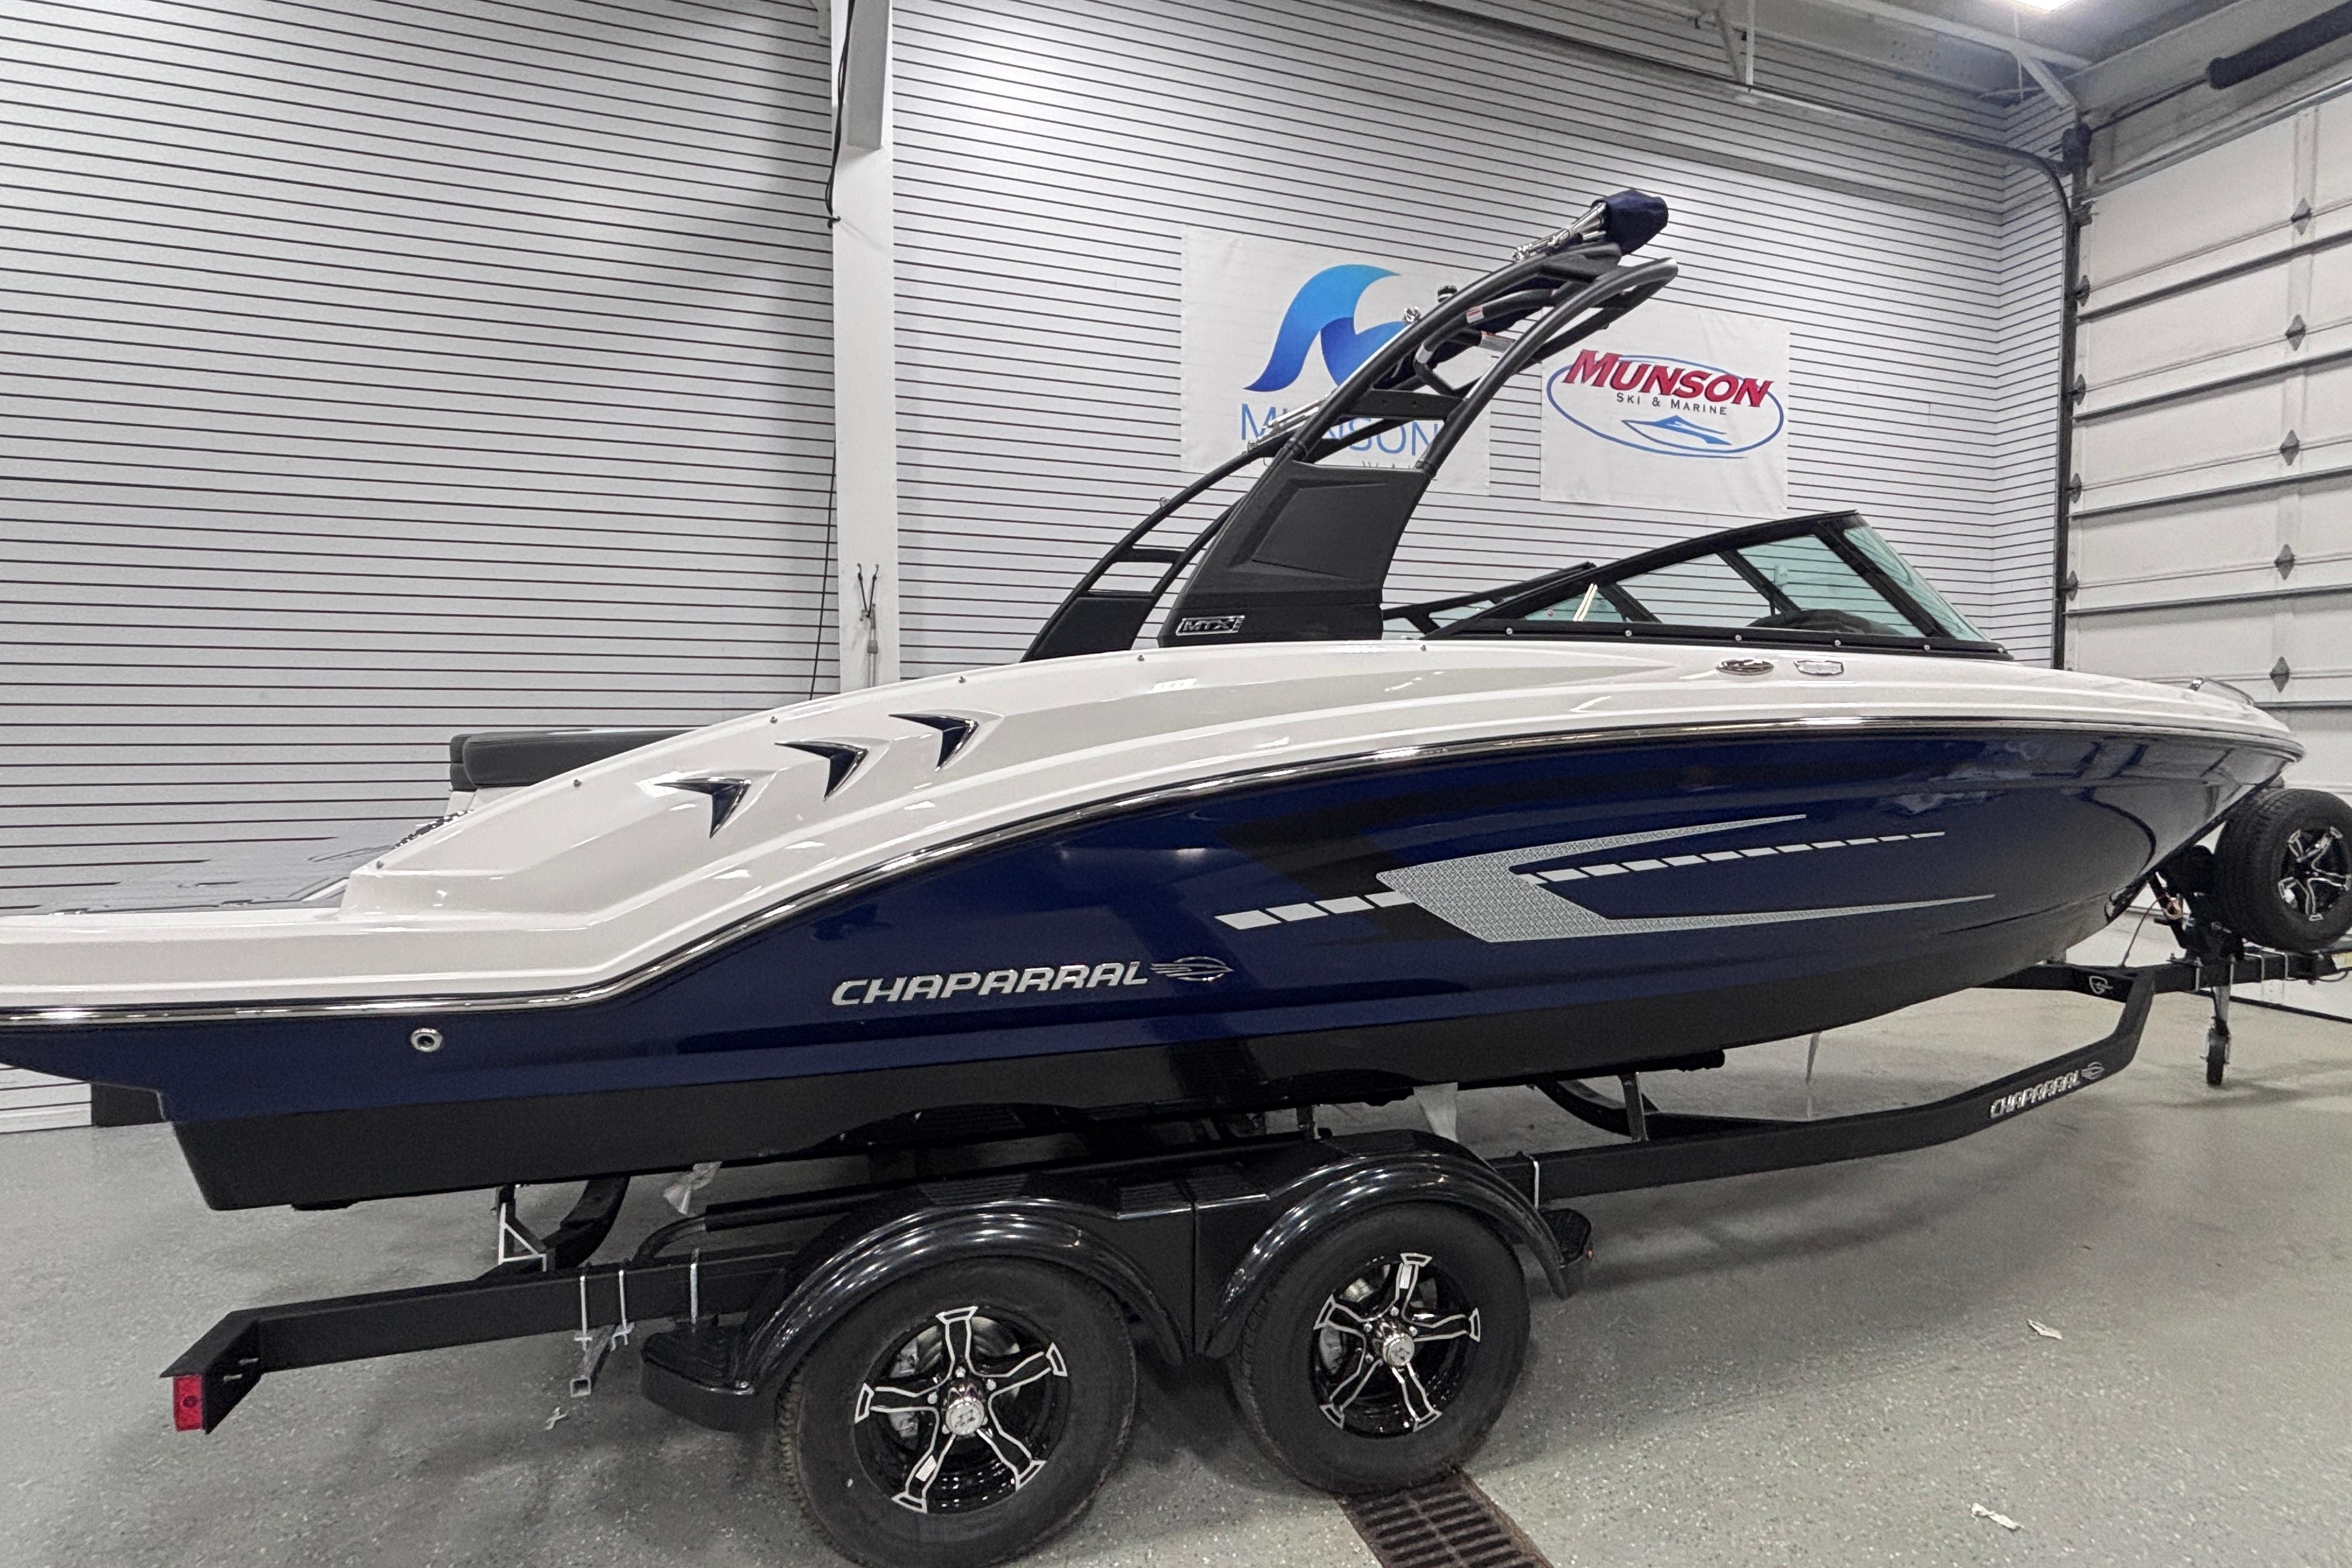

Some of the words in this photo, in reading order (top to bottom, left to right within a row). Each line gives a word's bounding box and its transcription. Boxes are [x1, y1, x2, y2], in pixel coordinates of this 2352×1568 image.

[1561, 349, 1774, 408] MUNSON
[1616, 393, 1641, 405] SKI
[1652, 397, 1660, 407] &
[1671, 398, 1727, 415] MARINE
[1241, 403, 1438, 457] MSON
[831, 961, 1149, 1006] CHAPARRAL
[1990, 1070, 2081, 1118] CHAPARRAL
